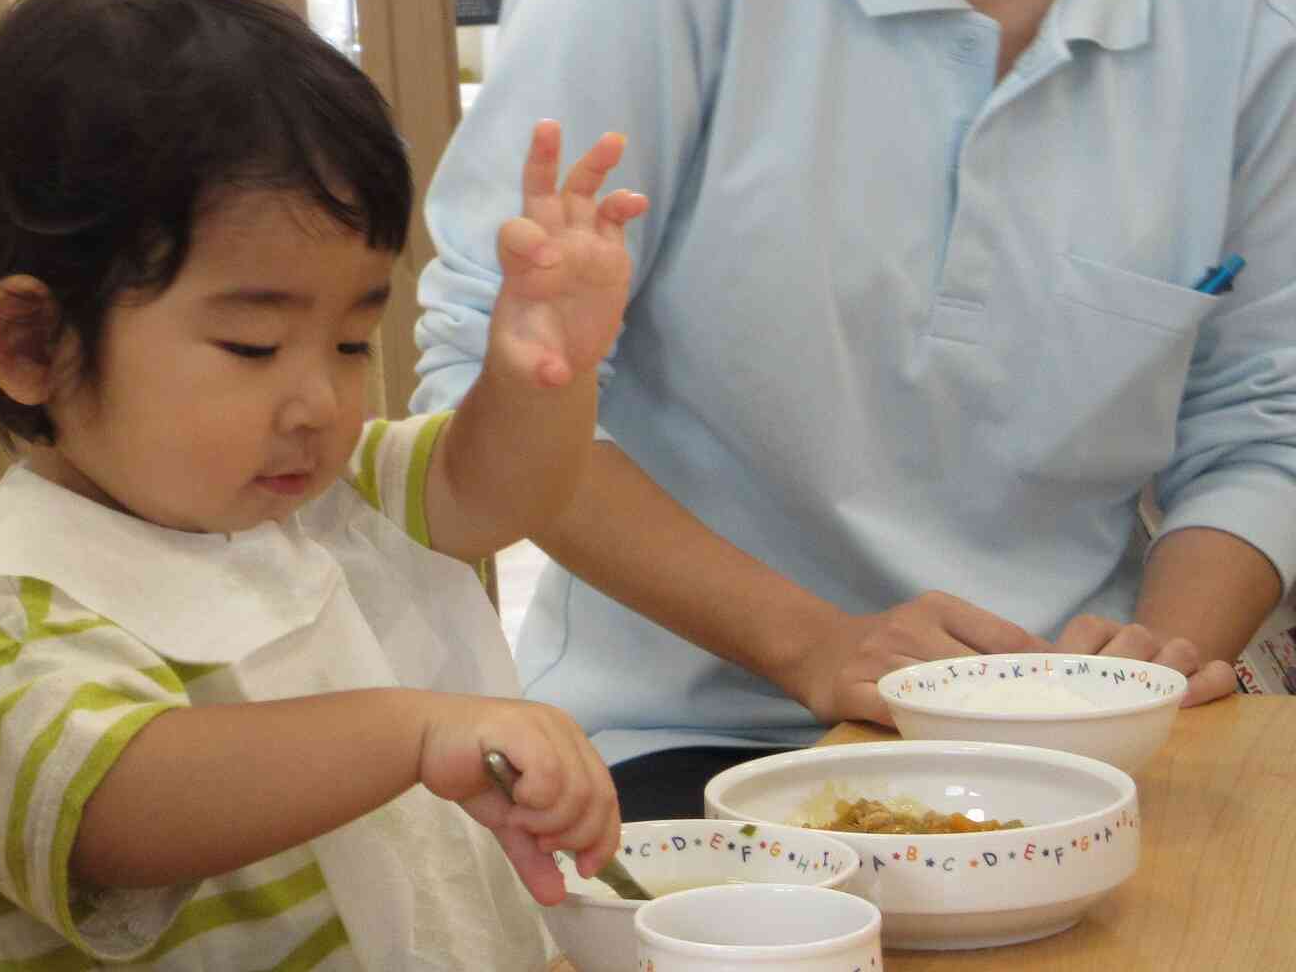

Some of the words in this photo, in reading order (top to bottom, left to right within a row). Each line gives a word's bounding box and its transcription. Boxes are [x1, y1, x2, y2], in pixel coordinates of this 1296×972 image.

[947, 665, 960, 678] I
[978, 663, 989, 676] J
[1011, 664, 1024, 677] K
[1077, 662, 1090, 674] M
[1113, 668, 1126, 684] N
[639, 842, 652, 857] C
[671, 836, 687, 851] D
[710, 832, 724, 850] E
[741, 845, 753, 863] F
[796, 855, 810, 874] H
[906, 845, 918, 862] B
[942, 857, 956, 872] C
[982, 851, 998, 867] D
[1023, 842, 1037, 861] E
[1054, 846, 1064, 866] F
